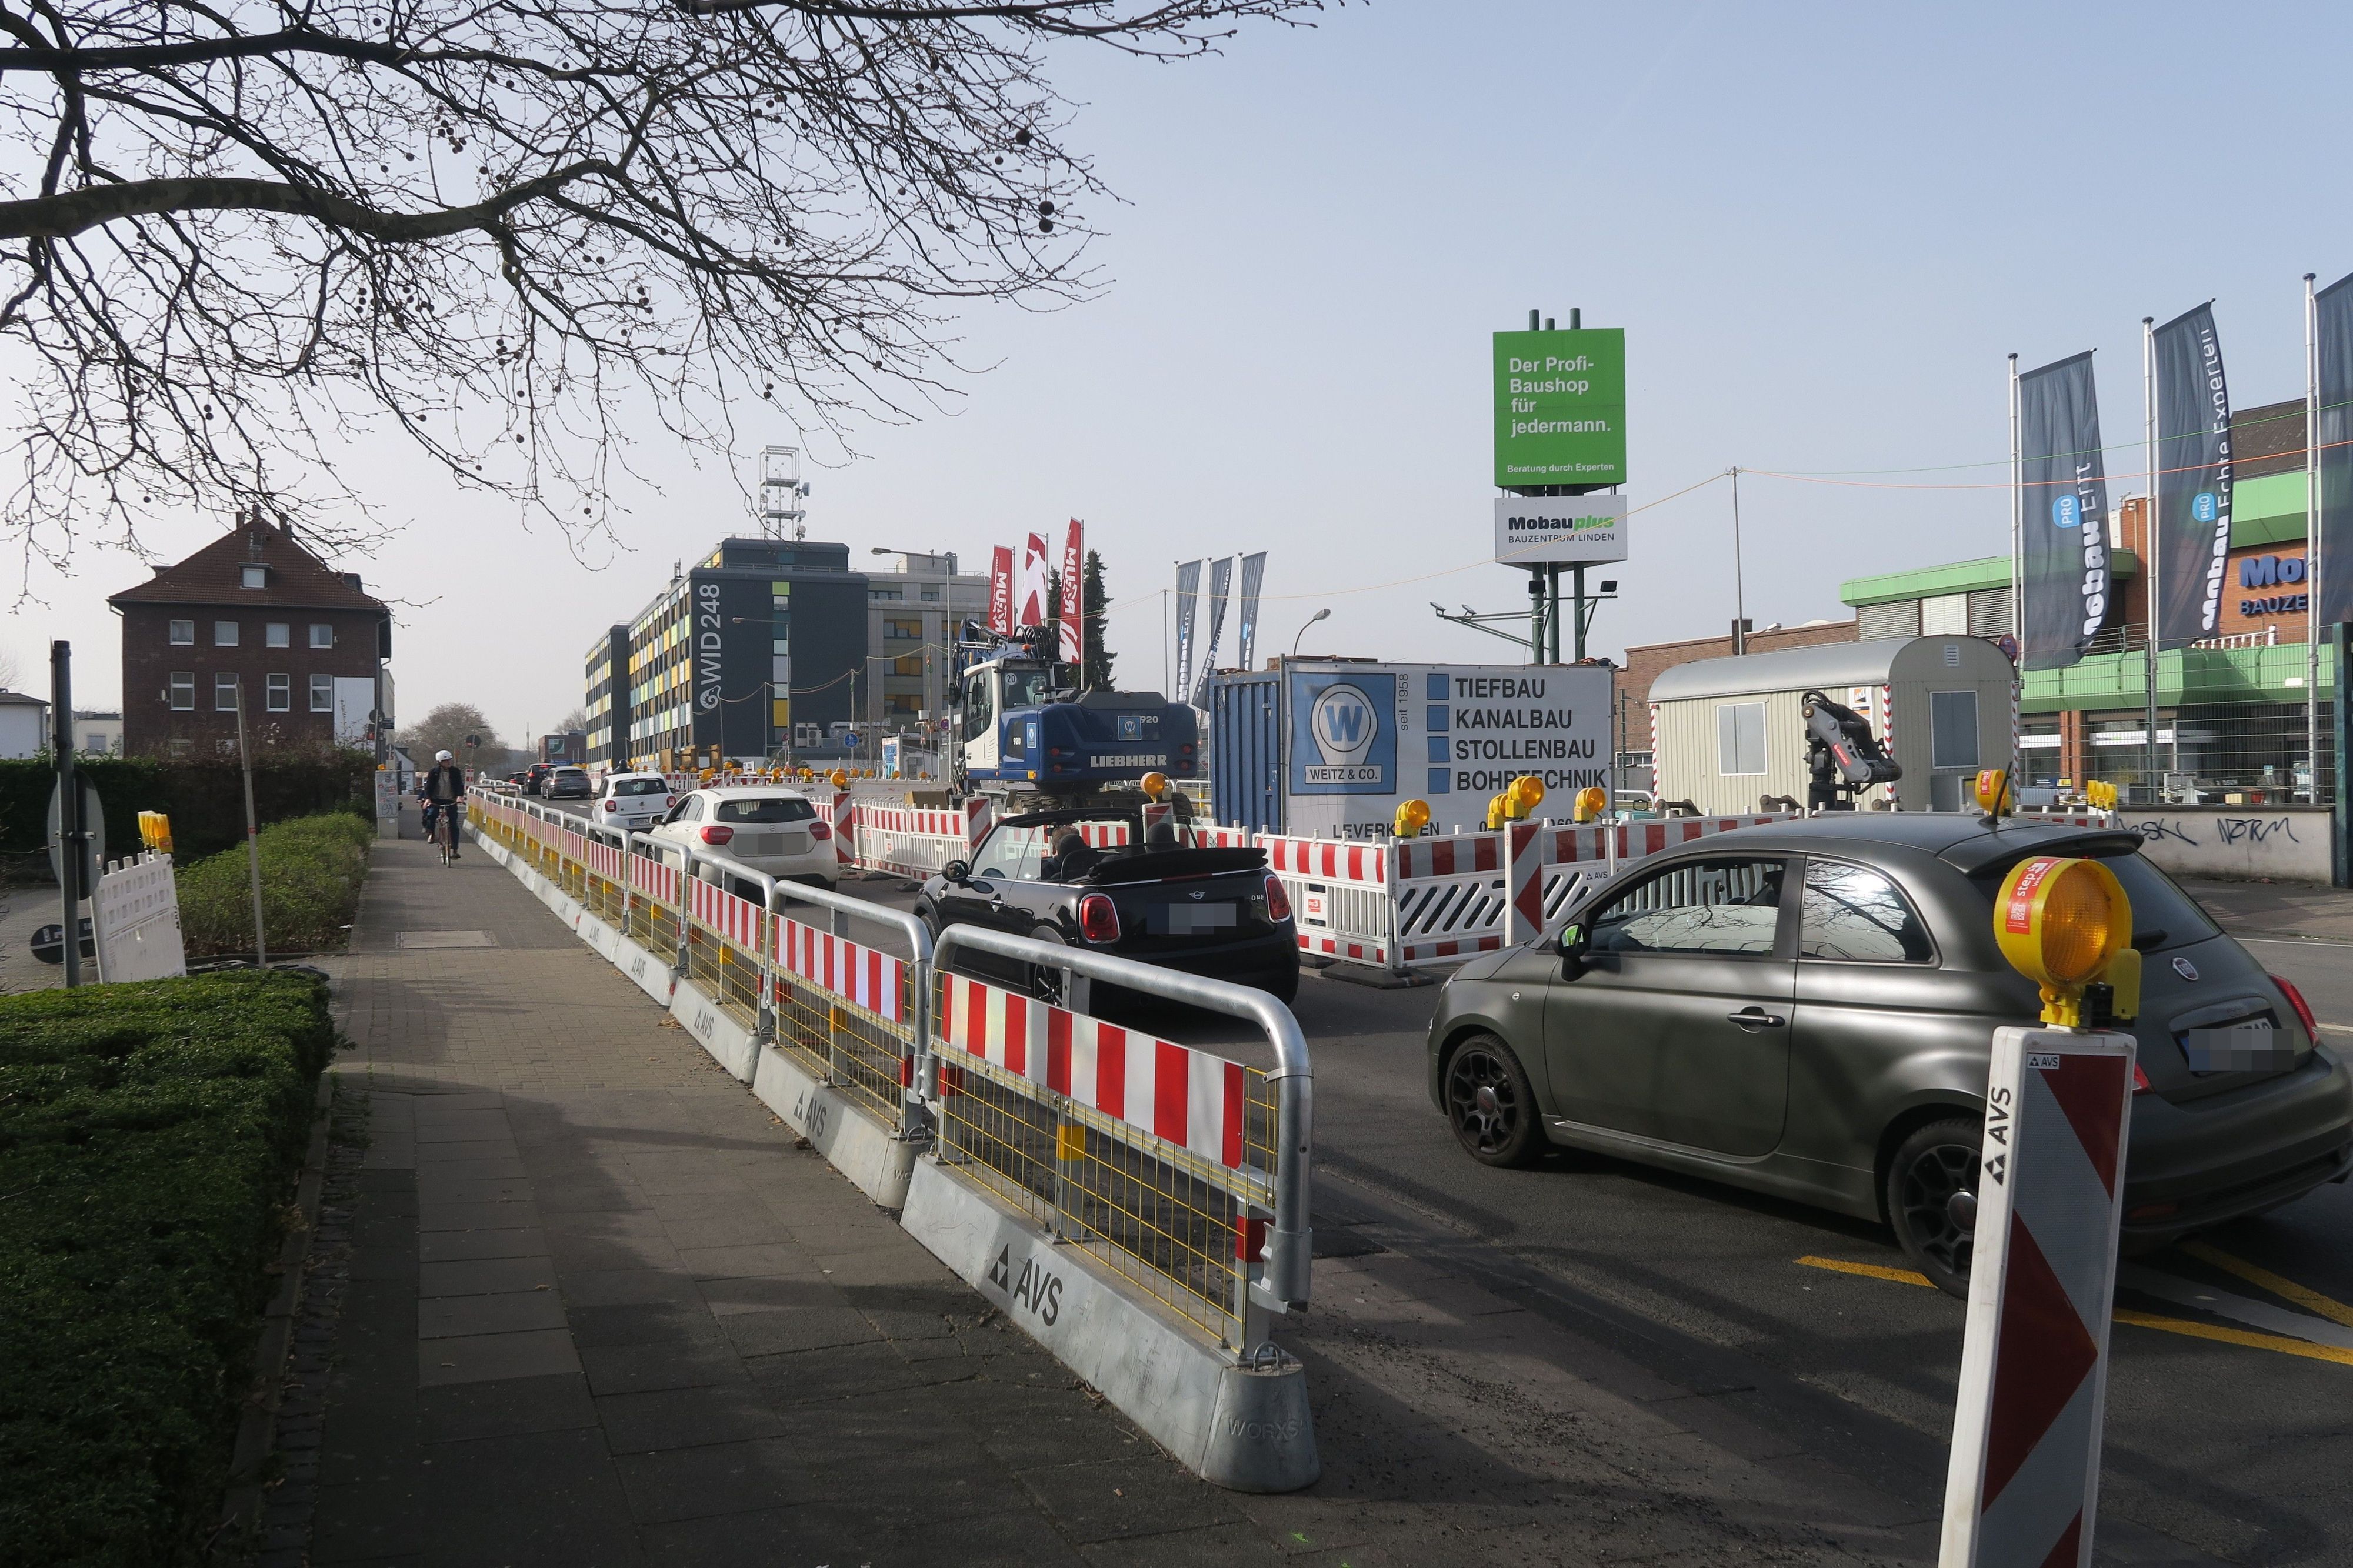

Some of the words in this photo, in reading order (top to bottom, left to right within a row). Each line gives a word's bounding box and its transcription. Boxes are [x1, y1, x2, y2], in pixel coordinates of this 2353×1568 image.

[1509, 358, 1540, 373] Der
[1546, 356, 1594, 371] Profi-
[1510, 378, 1589, 395] Baushop
[1511, 398, 1537, 413] für
[1511, 419, 1611, 438] jedermann.
[1507, 465, 1547, 473] Beratung
[1549, 463, 1573, 472] durch
[1576, 463, 1614, 472] Experten
[2061, 498, 2073, 524] PRO
[2199, 496, 2210, 518] PRO
[1508, 534, 1575, 543] BAUZENTRUM
[1578, 533, 1615, 541] LINDEN
[2240, 555, 2308, 587] Mo
[1006, 675, 1015, 683] 20
[1398, 673, 1408, 703] 1958
[1455, 678, 1545, 698] TIEFBAU
[1141, 715, 1159, 723] 920
[1325, 705, 1363, 742] W
[1398, 709, 1408, 731] seit
[1456, 709, 1572, 729] KANALBAU
[1013, 737, 1021, 745] 920
[1455, 739, 1595, 760] STOLLENBAU
[1090, 755, 1168, 768] LIEBHERR
[1309, 769, 1345, 780] WEITZ
[1348, 769, 1355, 780] &
[1358, 769, 1378, 780] CO.
[1333, 822, 1439, 838] LEVERKEN
[1594, 871, 1608, 879] AVS
[2017, 872, 2037, 897] step
[700, 1011, 715, 1040] AVS
[2041, 1057, 2058, 1067] AVS
[804, 1097, 827, 1137] AVS
[1988, 1087, 2011, 1146] AVS
[1014, 1257, 1063, 1327] AVS
